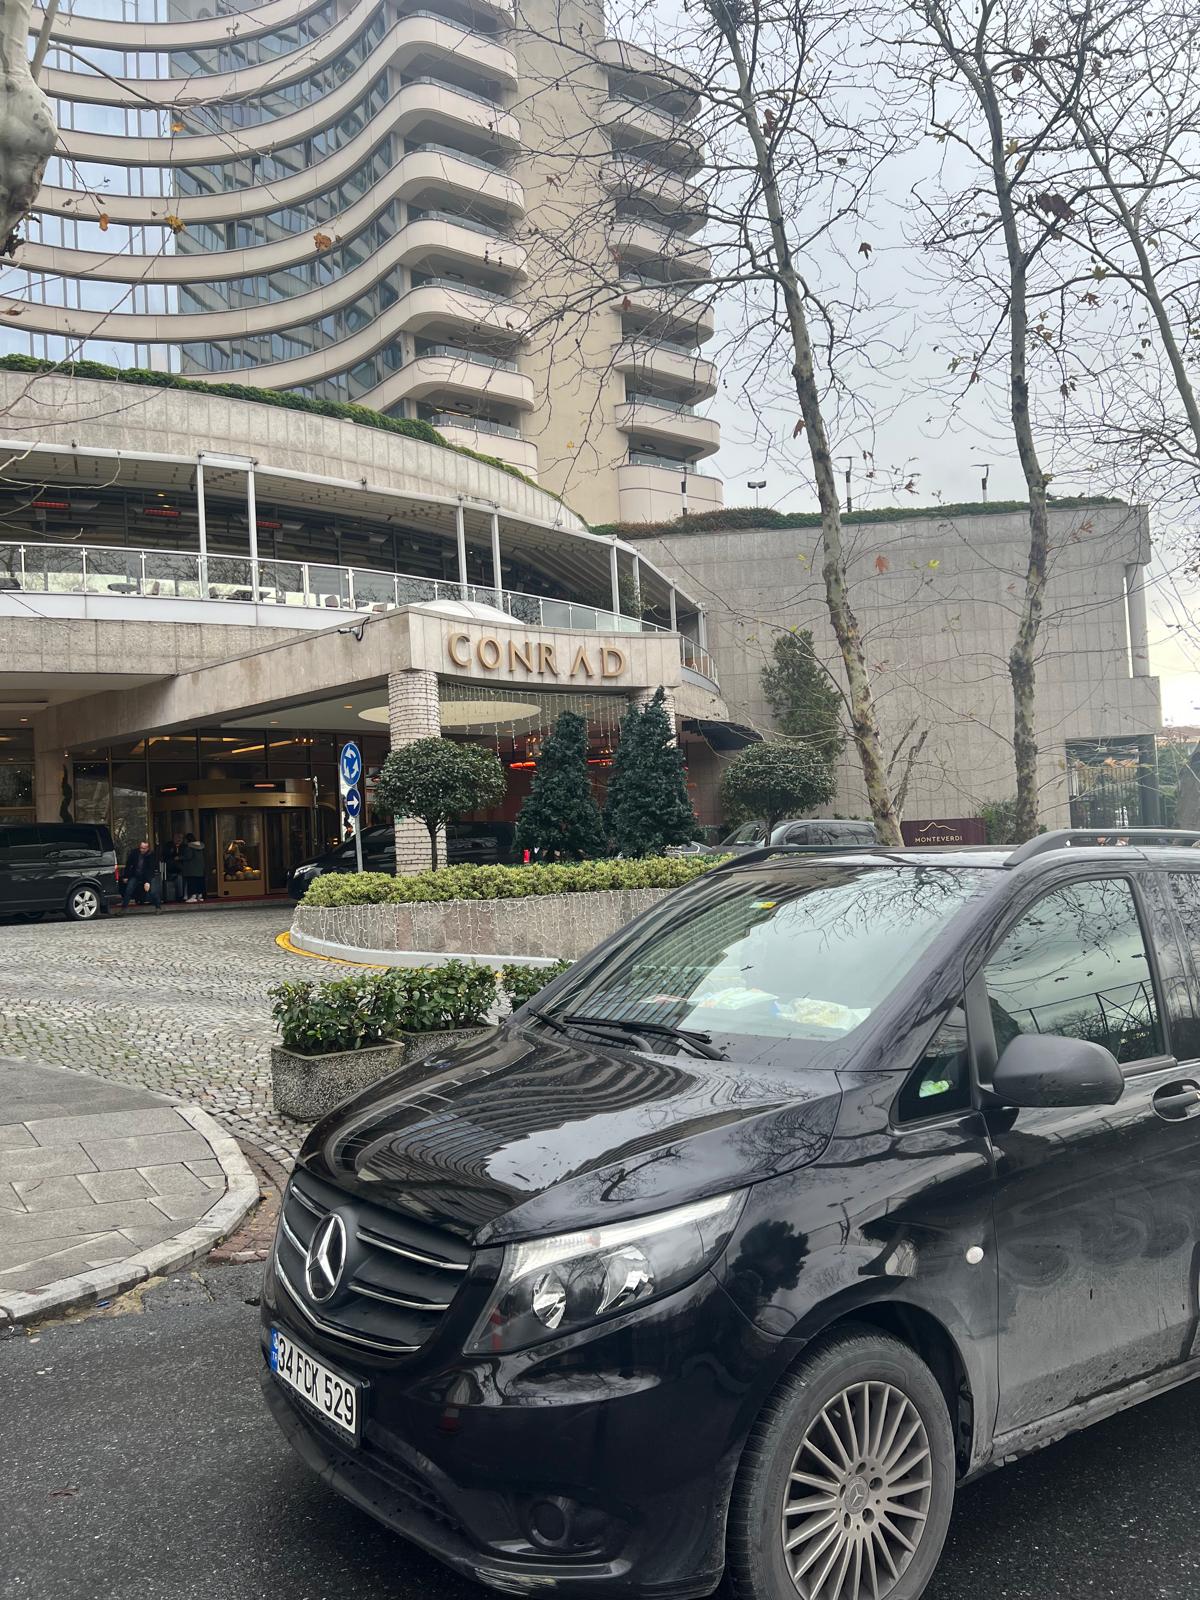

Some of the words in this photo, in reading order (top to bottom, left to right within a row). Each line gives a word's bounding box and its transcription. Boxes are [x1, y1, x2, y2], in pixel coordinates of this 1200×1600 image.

[448, 632, 626, 678] CONRAD
[914, 835, 963, 843] MONTEVERDI
[278, 1337, 293, 1379] 34
[296, 1351, 319, 1402] FCK
[324, 1373, 354, 1426] 529
